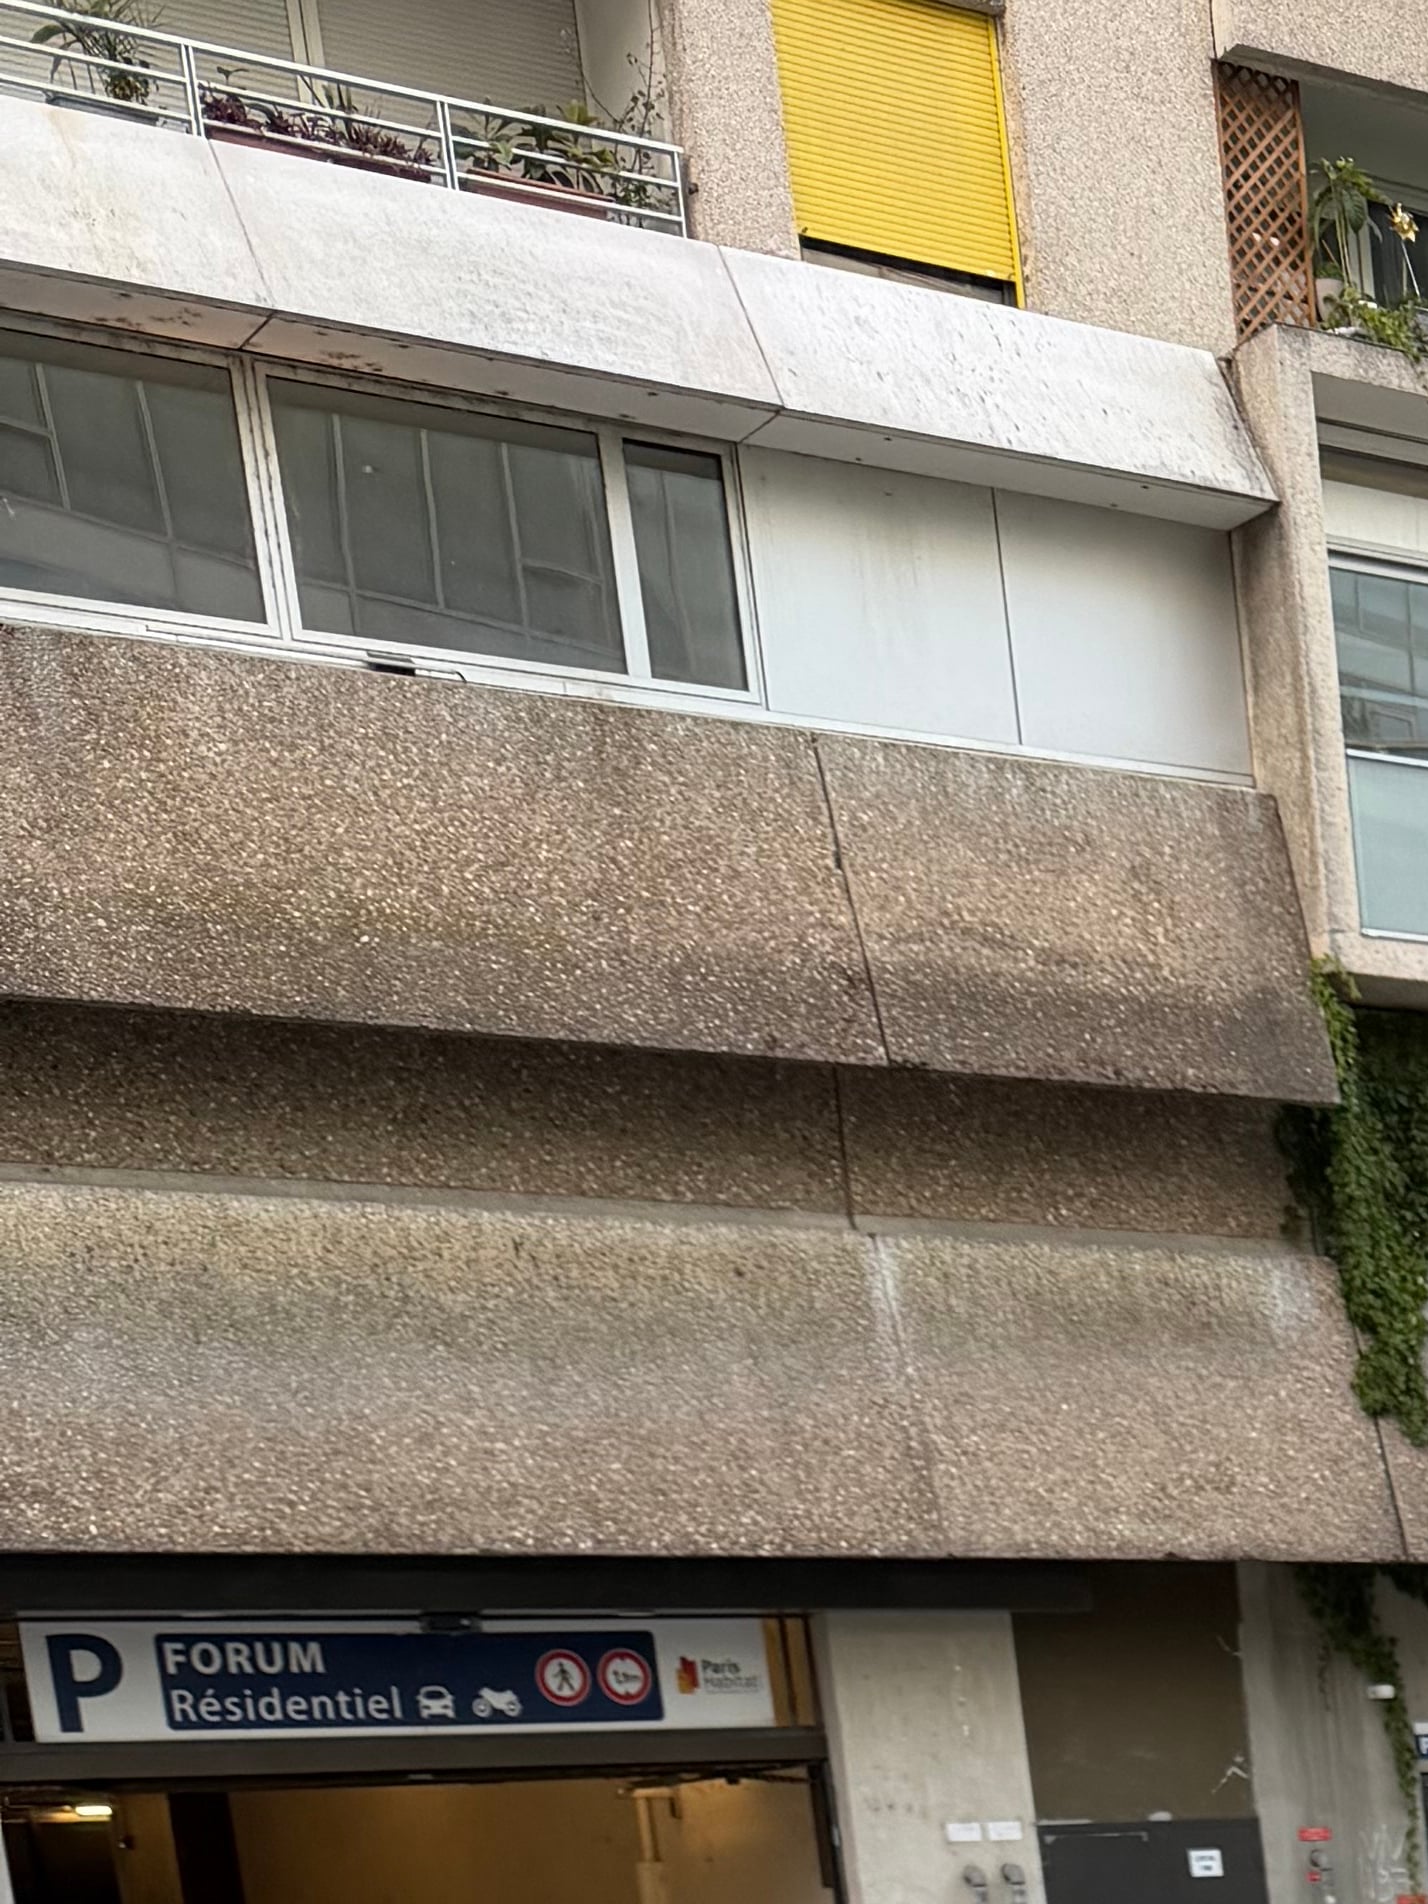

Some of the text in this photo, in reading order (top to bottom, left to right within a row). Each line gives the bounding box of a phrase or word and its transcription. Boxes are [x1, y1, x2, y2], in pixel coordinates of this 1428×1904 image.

[162, 1641, 327, 1675] FORUM
[702, 1657, 741, 1674] Paris
[45, 1633, 123, 1733] P
[169, 1686, 403, 1723] Résidentiel
